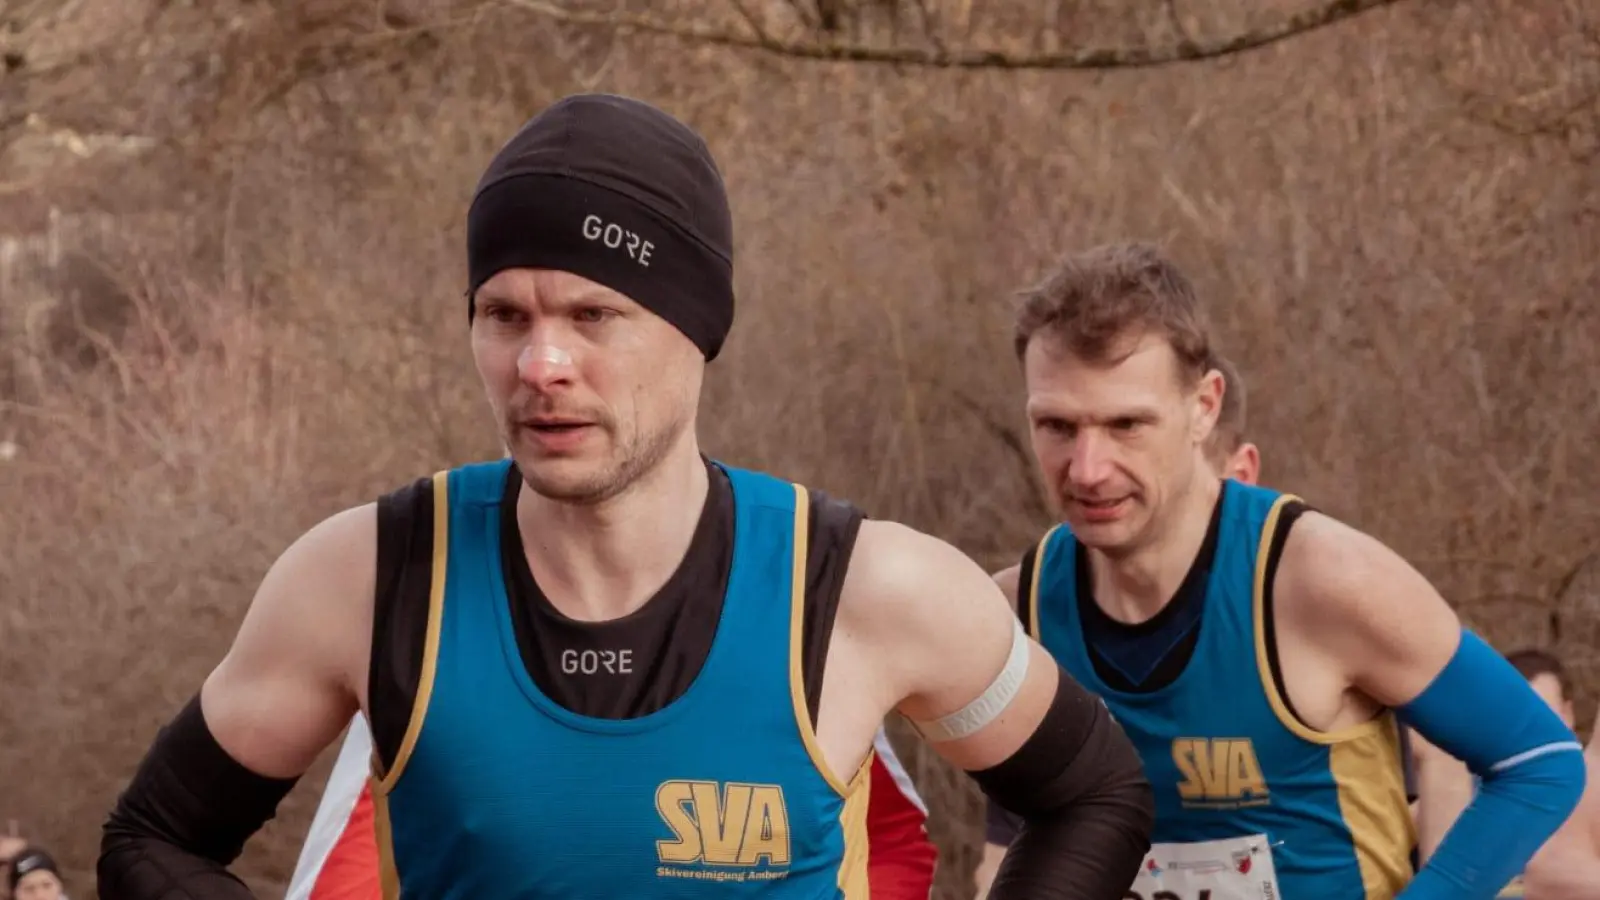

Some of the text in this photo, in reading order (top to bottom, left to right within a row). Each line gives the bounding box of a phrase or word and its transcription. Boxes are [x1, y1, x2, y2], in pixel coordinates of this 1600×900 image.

[582, 214, 655, 267] GORE
[561, 648, 633, 675] GORE
[1171, 737, 1270, 800] SVA
[655, 779, 791, 866] SVA
